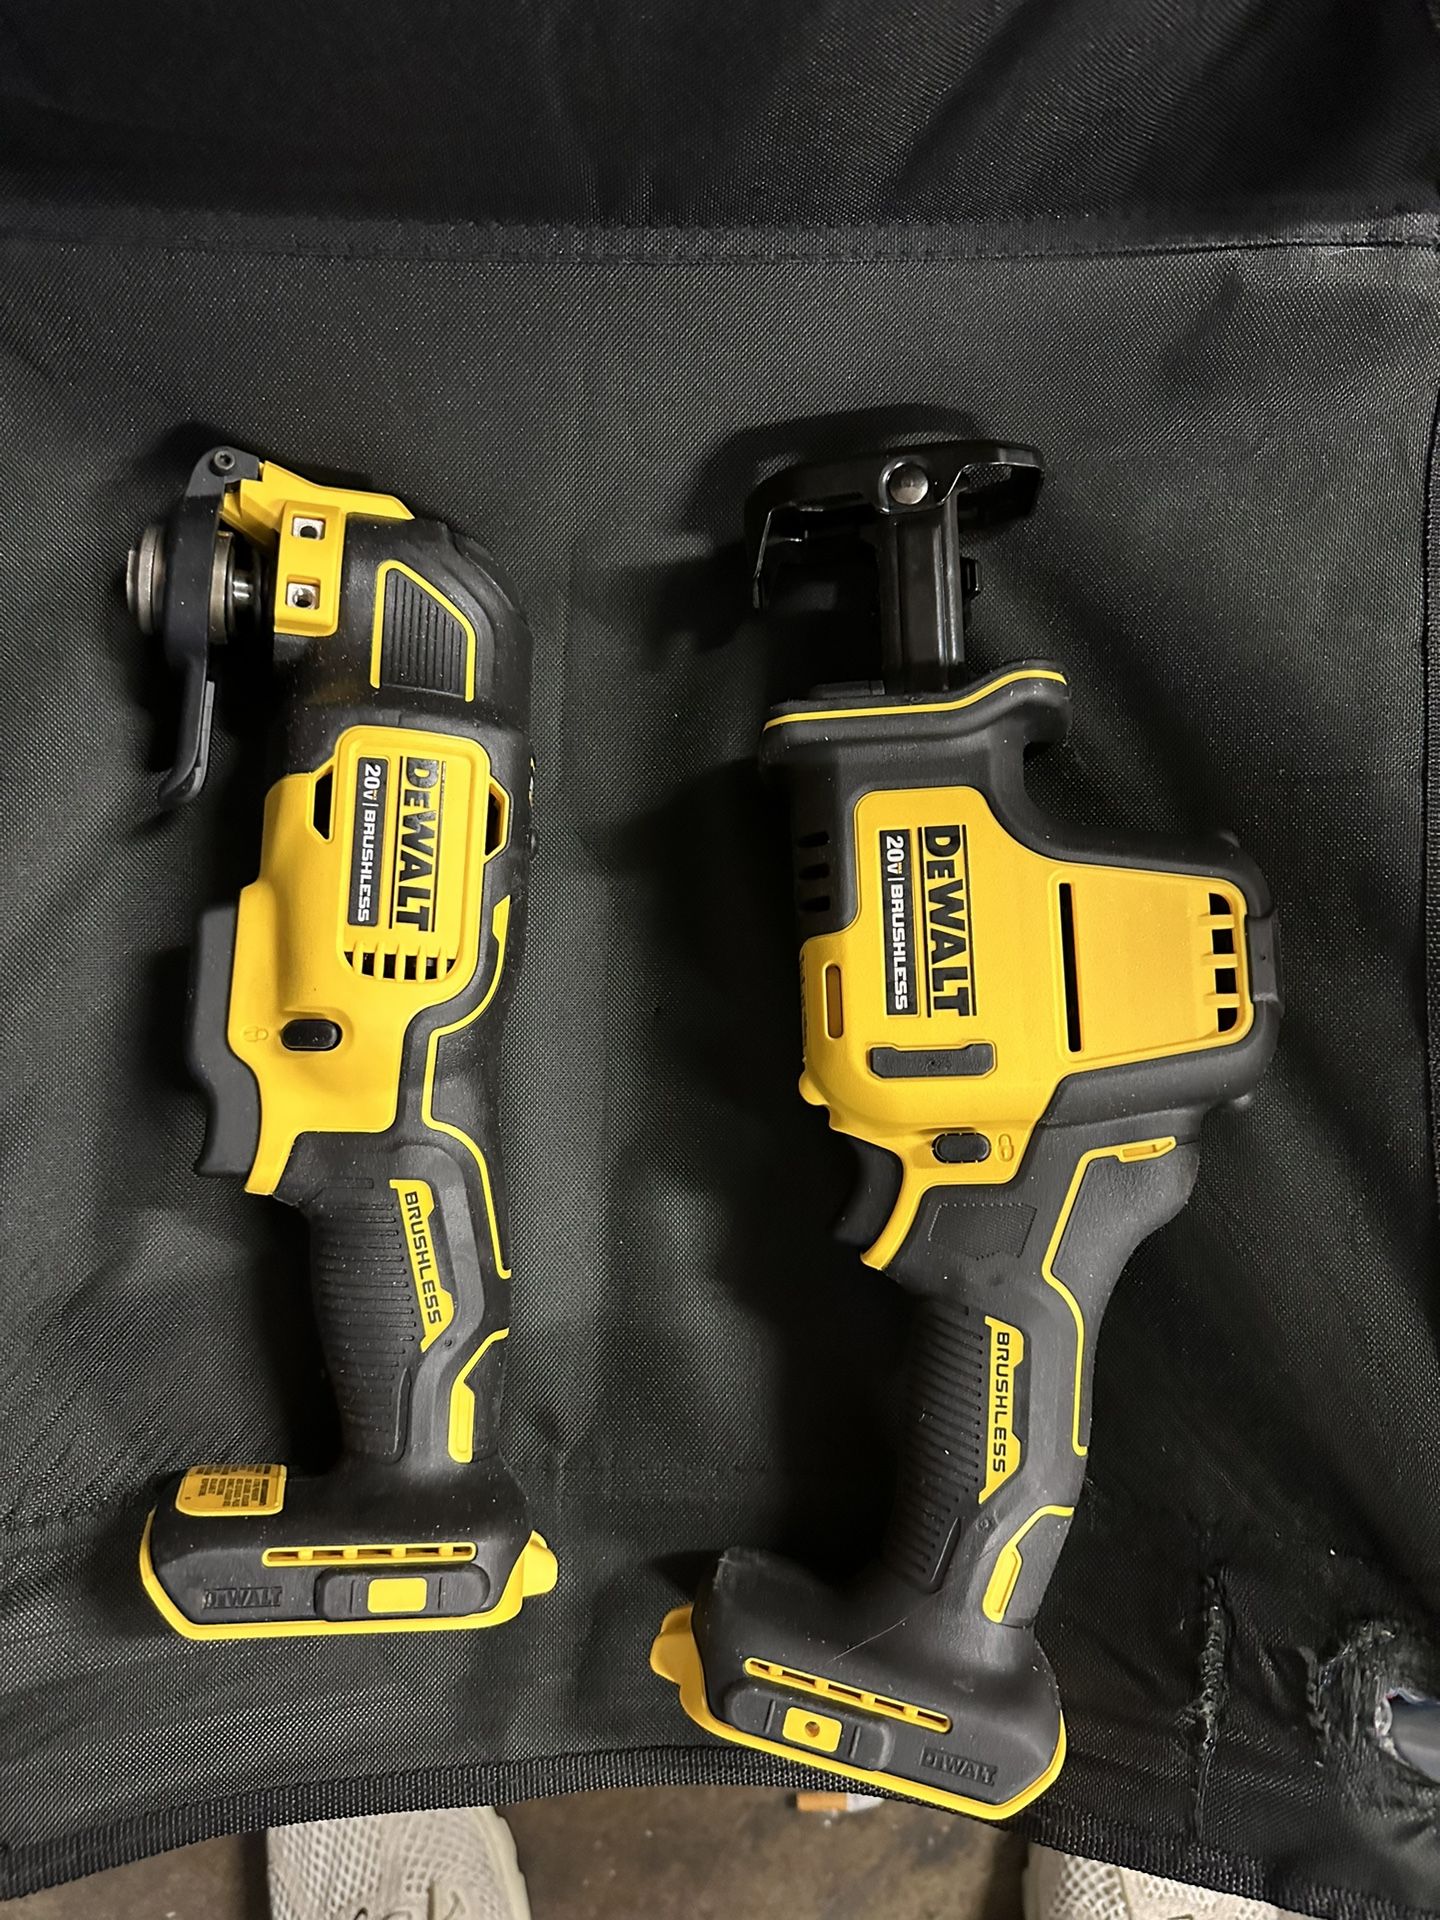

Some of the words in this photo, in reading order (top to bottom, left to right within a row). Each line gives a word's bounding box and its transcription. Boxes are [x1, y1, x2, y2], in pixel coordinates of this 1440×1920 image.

[357, 809, 377, 923] BRUSHLESS
[396, 756, 440, 932] DEWALT
[890, 883, 909, 1011] BRUSHLESS
[924, 824, 970, 1017] DEWALT
[404, 1190, 443, 1325] BRUSHLESS
[992, 1331, 1011, 1474] BRUSHLESS
